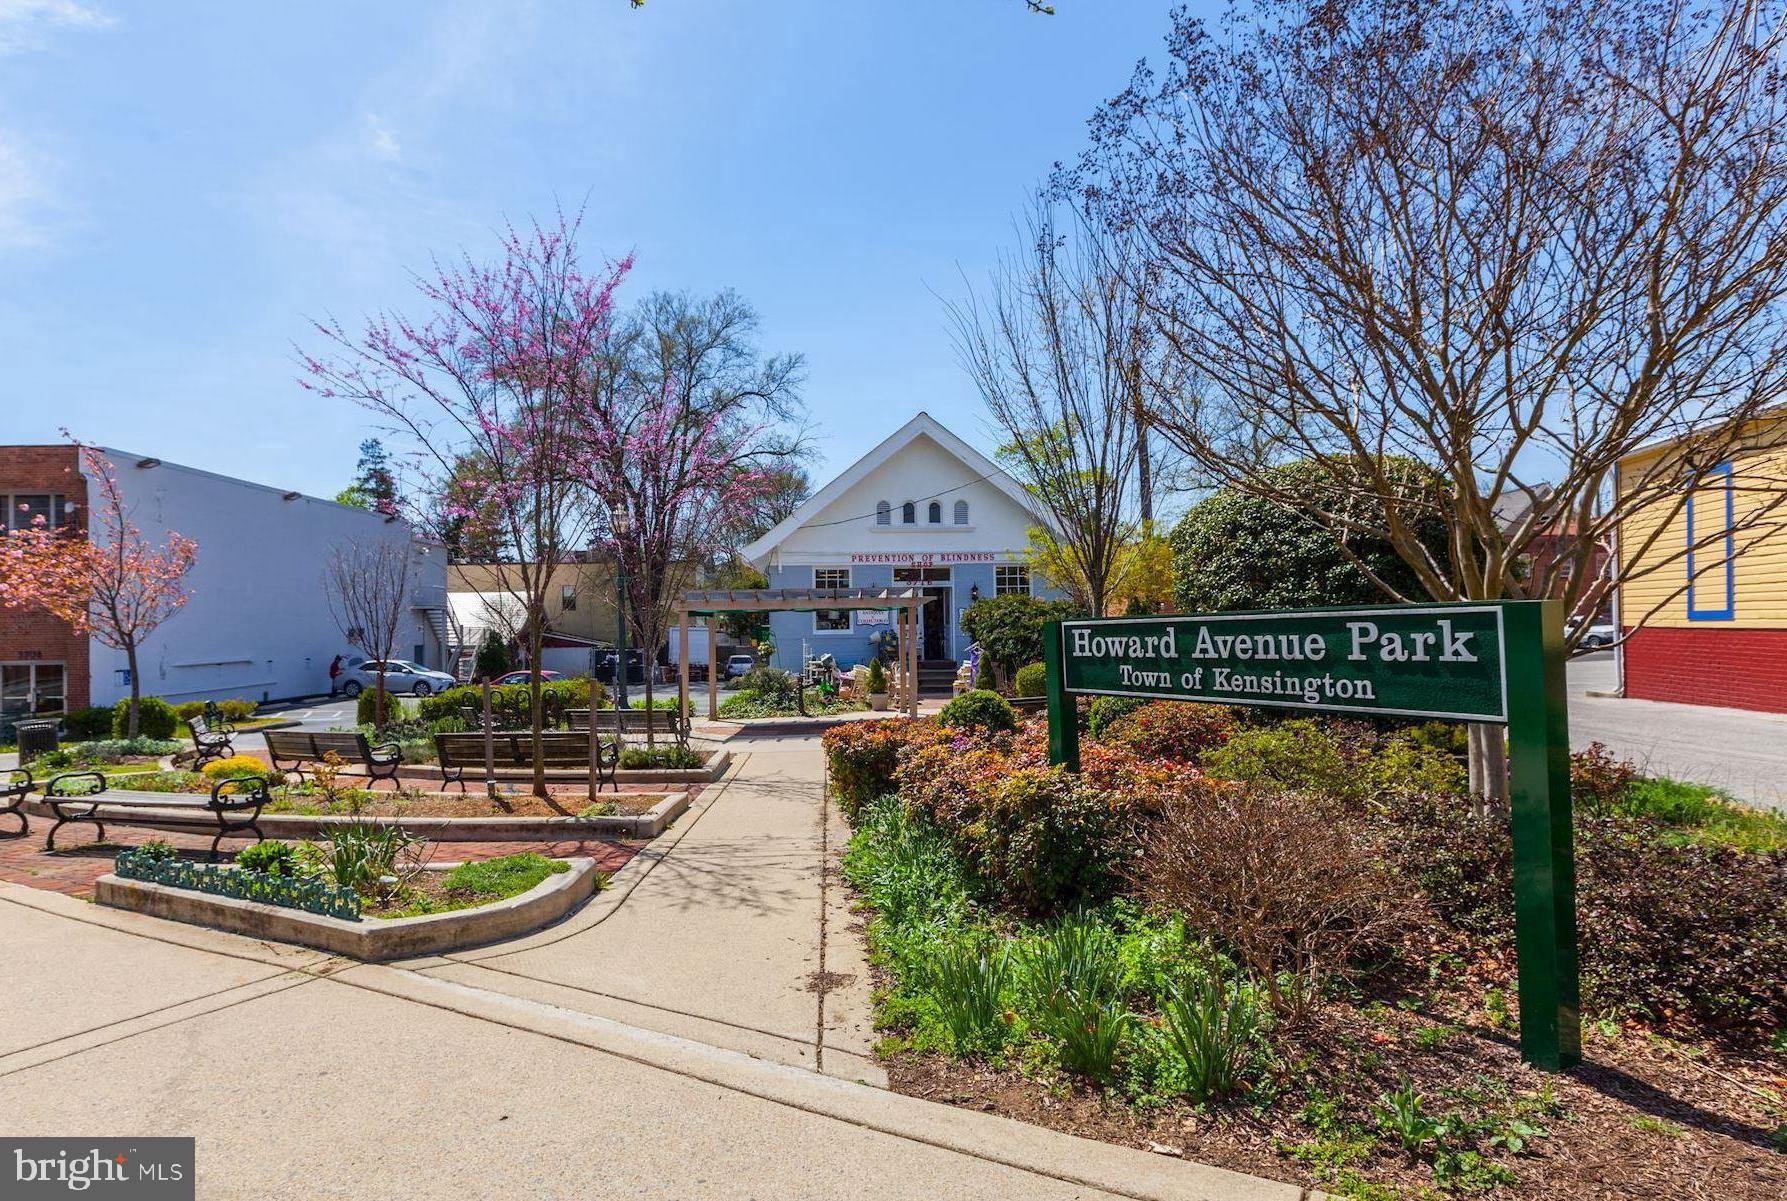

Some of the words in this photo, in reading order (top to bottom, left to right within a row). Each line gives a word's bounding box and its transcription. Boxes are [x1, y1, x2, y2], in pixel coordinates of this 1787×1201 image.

[851, 554, 915, 562] PREVENTION
[922, 554, 934, 562] OF
[940, 553, 995, 561] BLINDNESS
[1071, 626, 1178, 658] Howard
[1192, 625, 1326, 661] Avenue
[1346, 619, 1478, 662] Park
[1119, 664, 1172, 688] Town
[1181, 667, 1203, 689] of
[1212, 667, 1376, 704] Kensington
